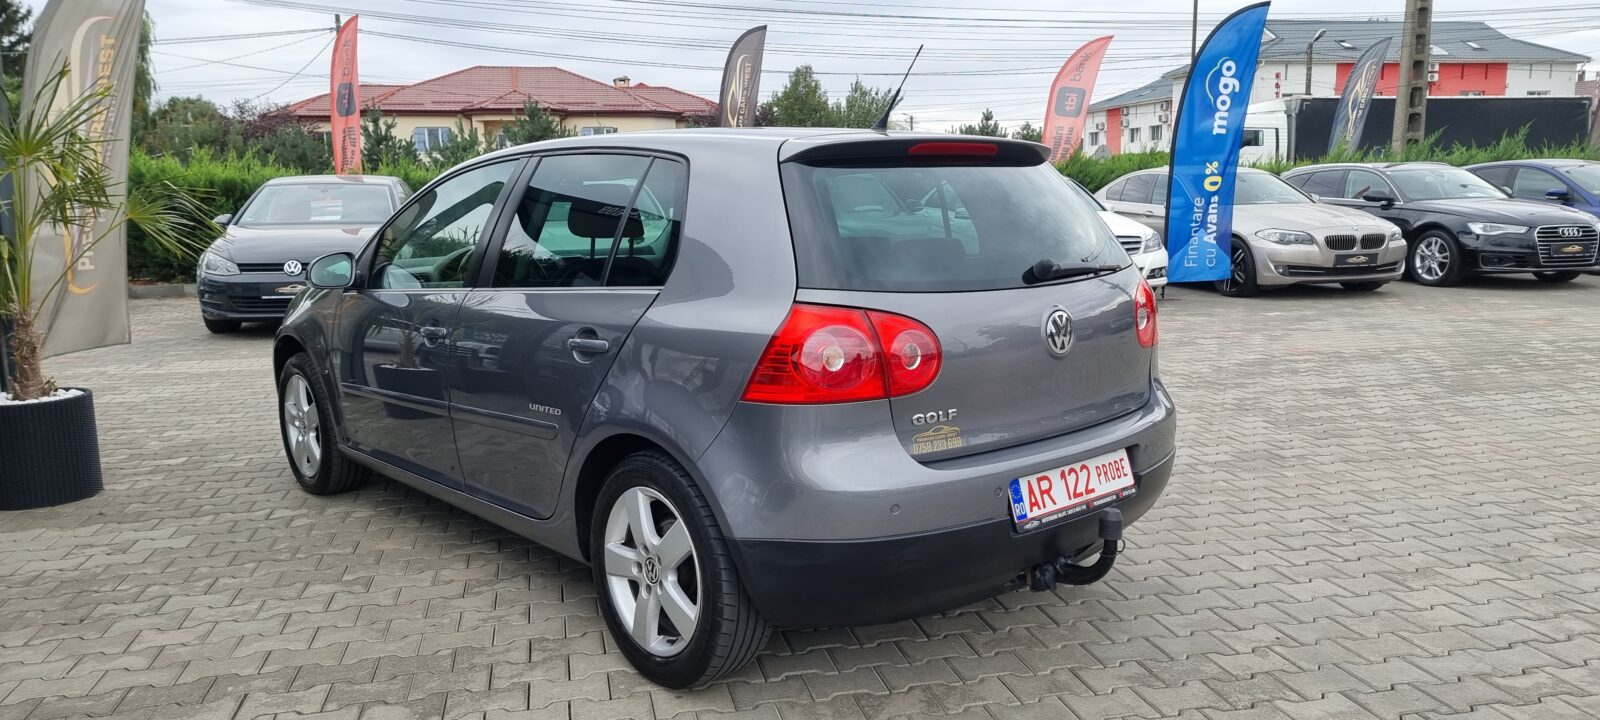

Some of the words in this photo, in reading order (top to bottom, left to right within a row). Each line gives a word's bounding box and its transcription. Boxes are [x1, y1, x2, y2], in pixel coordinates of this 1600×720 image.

[1070, 51, 1092, 82] bank
[1065, 93, 1079, 112] tbi
[1213, 59, 1240, 135] mogo
[1204, 161, 1222, 192] 0%
[1204, 195, 1219, 245] Avans
[1206, 248, 1217, 267] cu
[912, 408, 957, 426] GOLF
[1015, 502, 1026, 516] RO
[1027, 475, 1057, 513] AR
[1060, 464, 1095, 500] 122
[1095, 458, 1128, 485] PROBE
